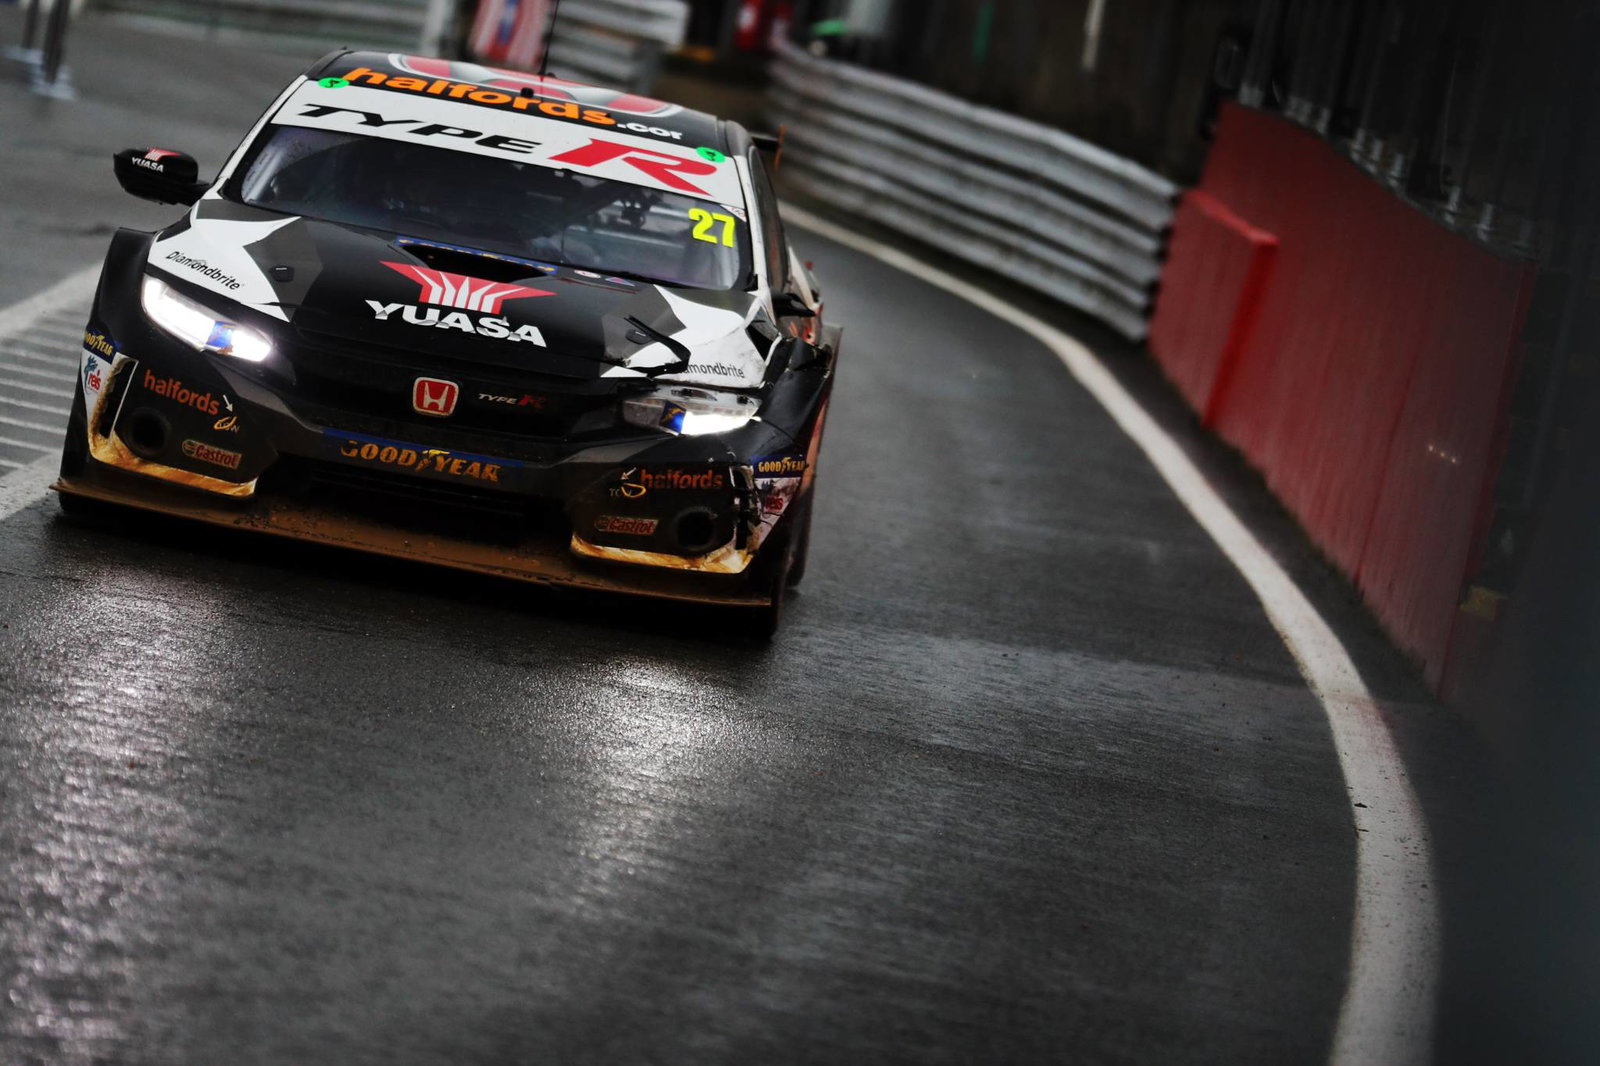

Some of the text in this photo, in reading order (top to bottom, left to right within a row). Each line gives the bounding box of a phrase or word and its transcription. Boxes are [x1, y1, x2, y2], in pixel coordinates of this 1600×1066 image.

[131, 156, 164, 173] YUASA
[298, 103, 718, 197] TYPE R
[688, 207, 736, 248] 27
[166, 251, 241, 290] Diamondbrite
[365, 300, 547, 348] YUASA
[143, 369, 221, 416] halfords
[478, 393, 517, 405] TYPE
[196, 444, 238, 467] Castrol
[641, 468, 724, 489] halfords
